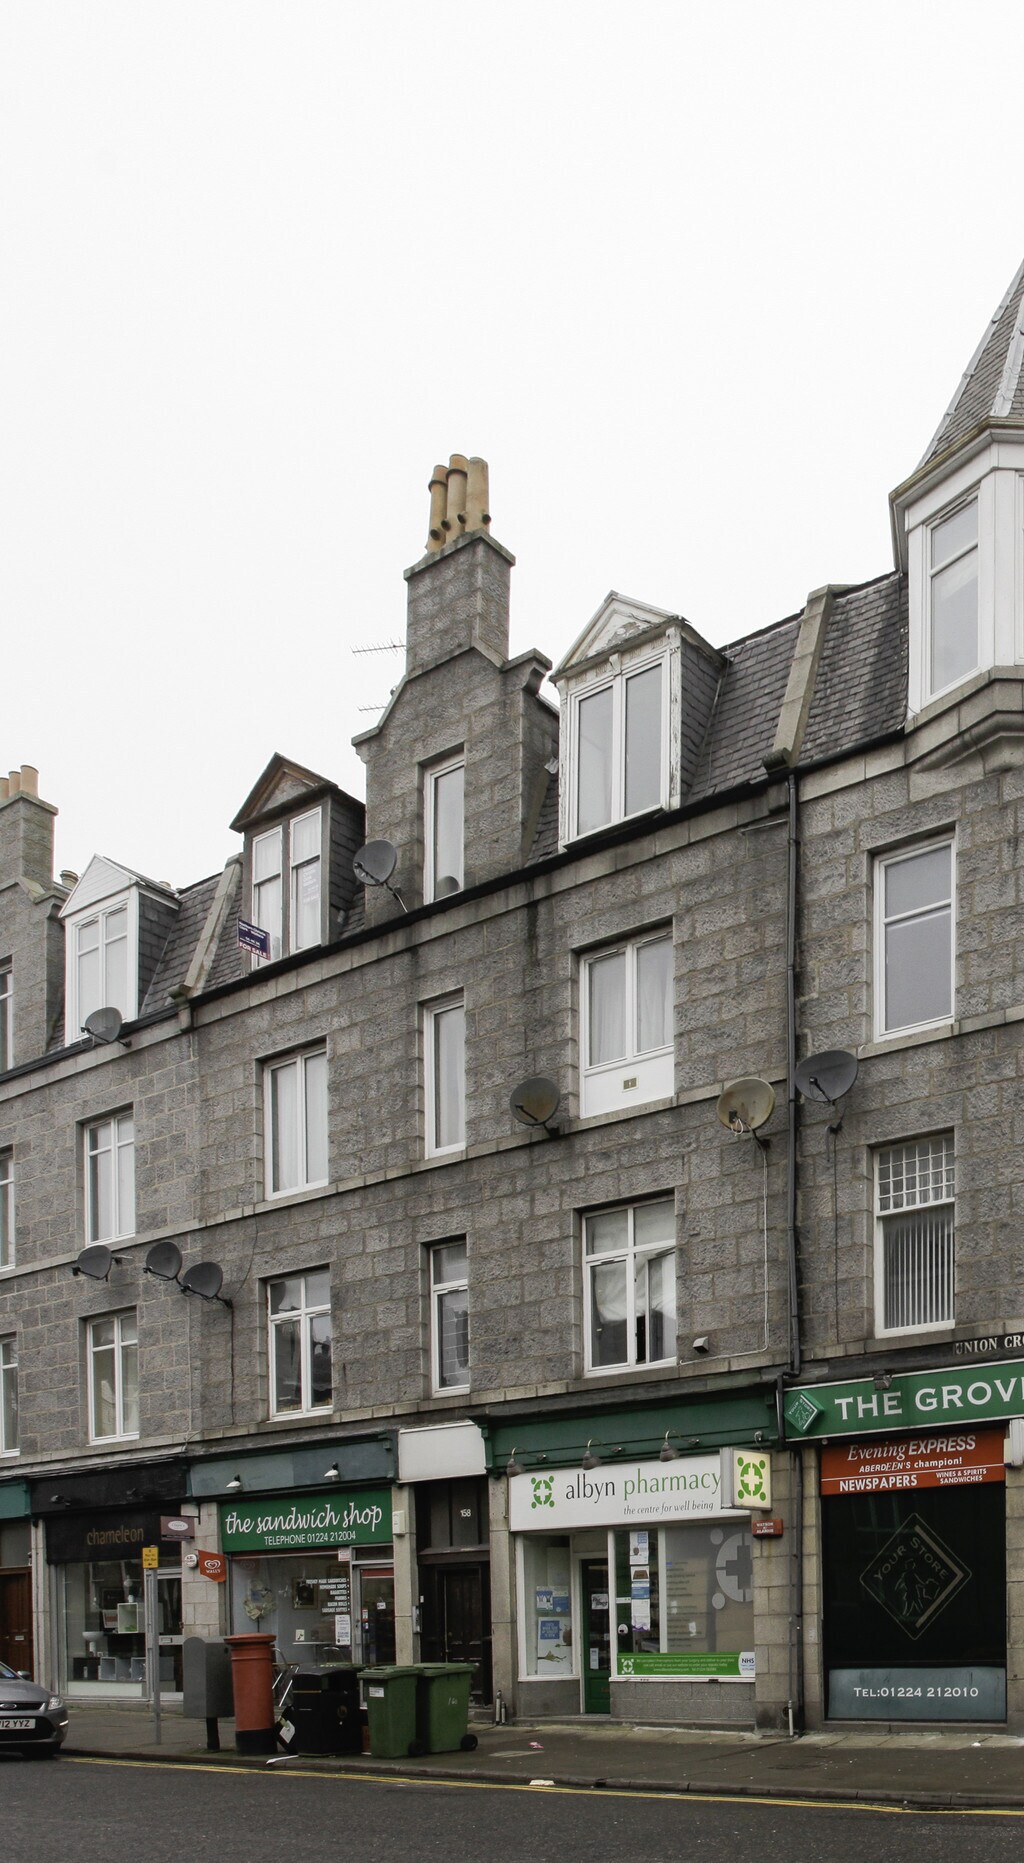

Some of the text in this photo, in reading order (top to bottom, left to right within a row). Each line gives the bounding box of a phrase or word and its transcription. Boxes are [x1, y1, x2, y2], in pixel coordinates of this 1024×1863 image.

[956, 1337, 998, 1355] UNION
[834, 1392, 902, 1420] THE
[847, 1436, 976, 1462] Evening EXPRESS
[859, 1457, 962, 1473] ABERDEEN'S champion!
[936, 1470, 956, 1478] WINES
[964, 1468, 987, 1476] SPIRITS
[566, 1468, 721, 1504] albyn pharmacy
[840, 1474, 918, 1492] NEWSPAPERS
[940, 1475, 983, 1484] SANDWICHES
[624, 1501, 714, 1515] the centre for well being
[225, 1502, 382, 1534] the sandwich shop
[87, 1525, 144, 1546] chameleon
[264, 1530, 356, 1546] TELEPHONE 01224 212004
[874, 1545, 907, 1581] YOUR
[910, 1537, 949, 1580] STORE
[854, 1687, 978, 1697] TEL:01224 212010
